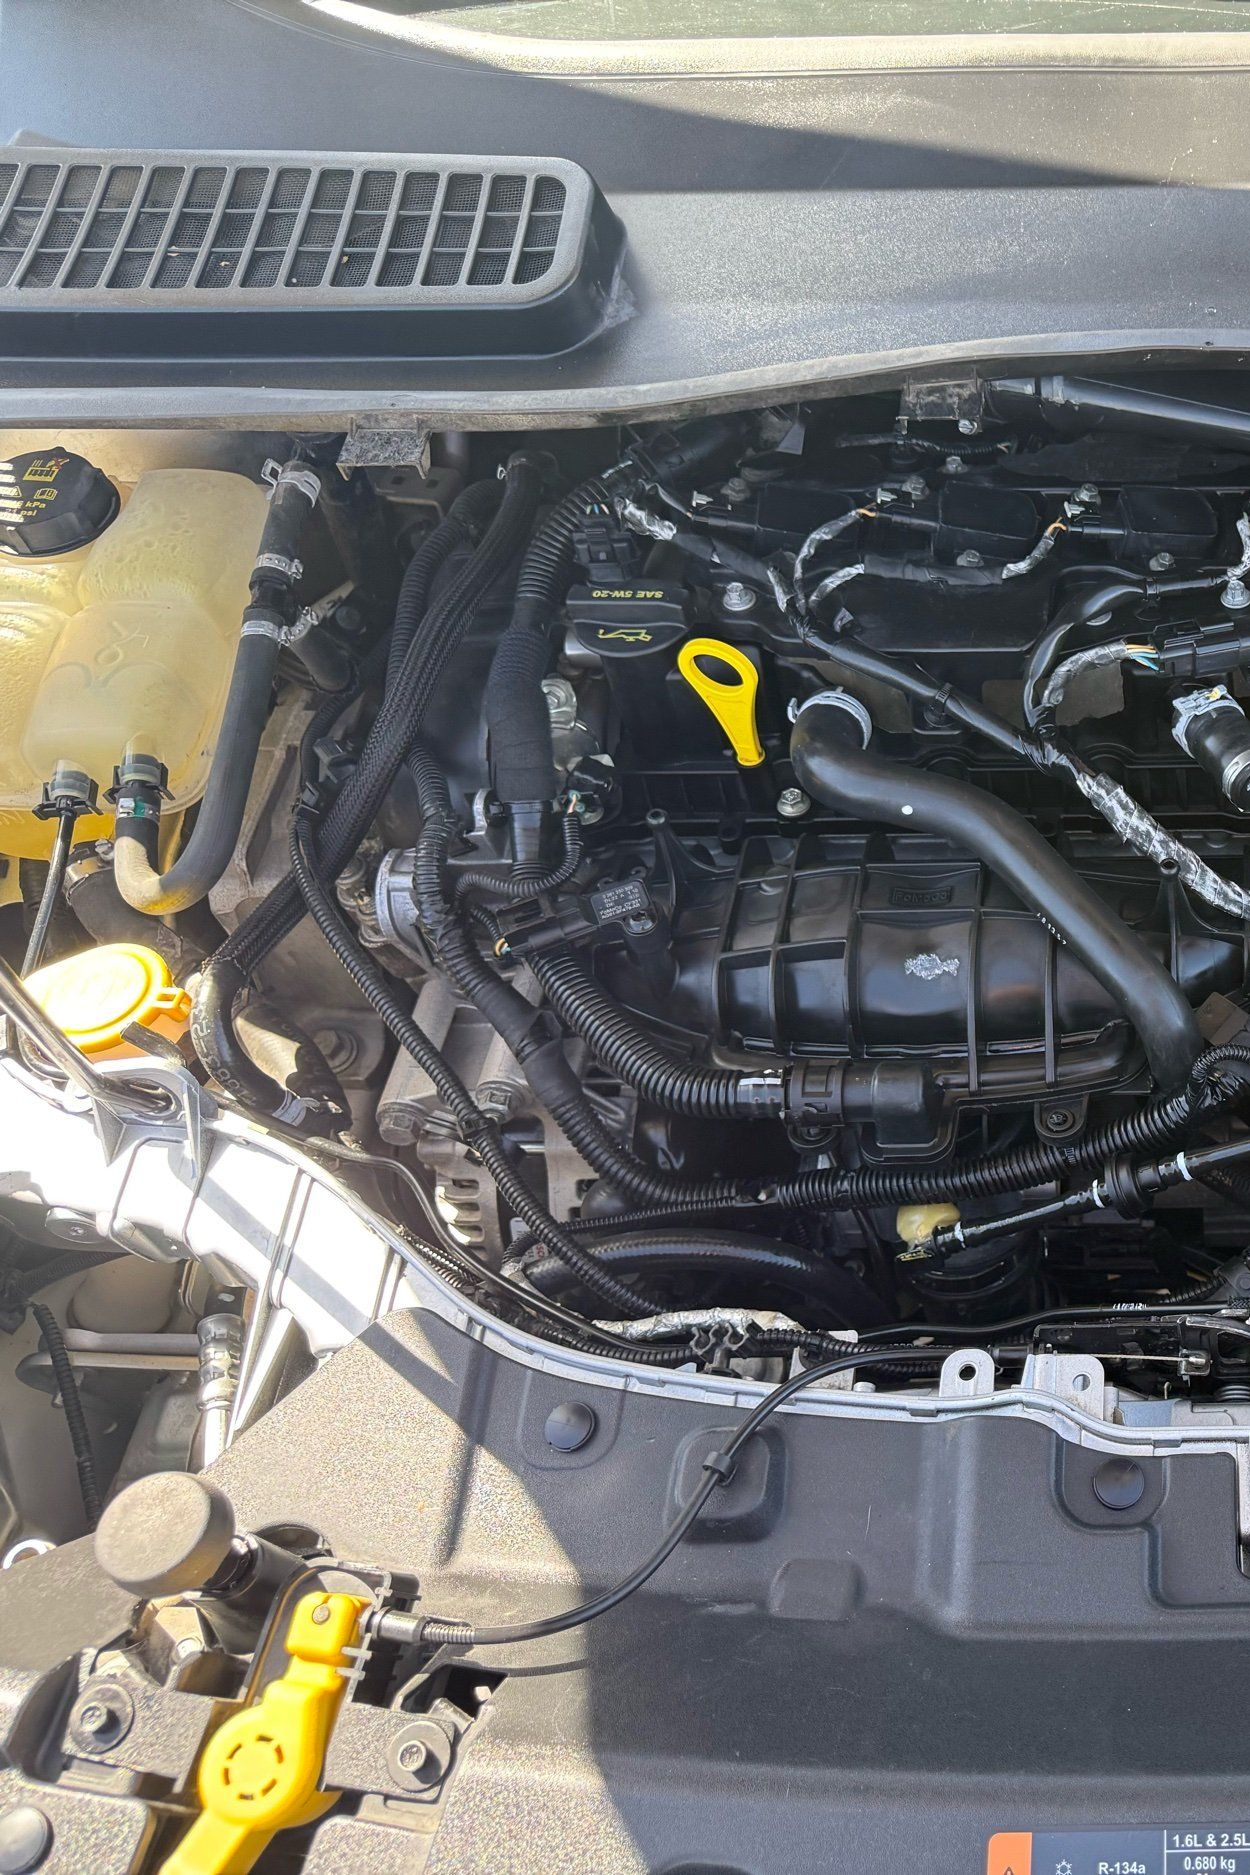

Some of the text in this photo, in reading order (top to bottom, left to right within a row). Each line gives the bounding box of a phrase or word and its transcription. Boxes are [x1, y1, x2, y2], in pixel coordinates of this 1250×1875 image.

[592, 590, 664, 598] SAE 5W-20
[1173, 1833, 1250, 1847] 1.6L & 2.5L
[1098, 1862, 1145, 1875] R-134a
[1184, 1856, 1235, 1872] 0.680 kg
